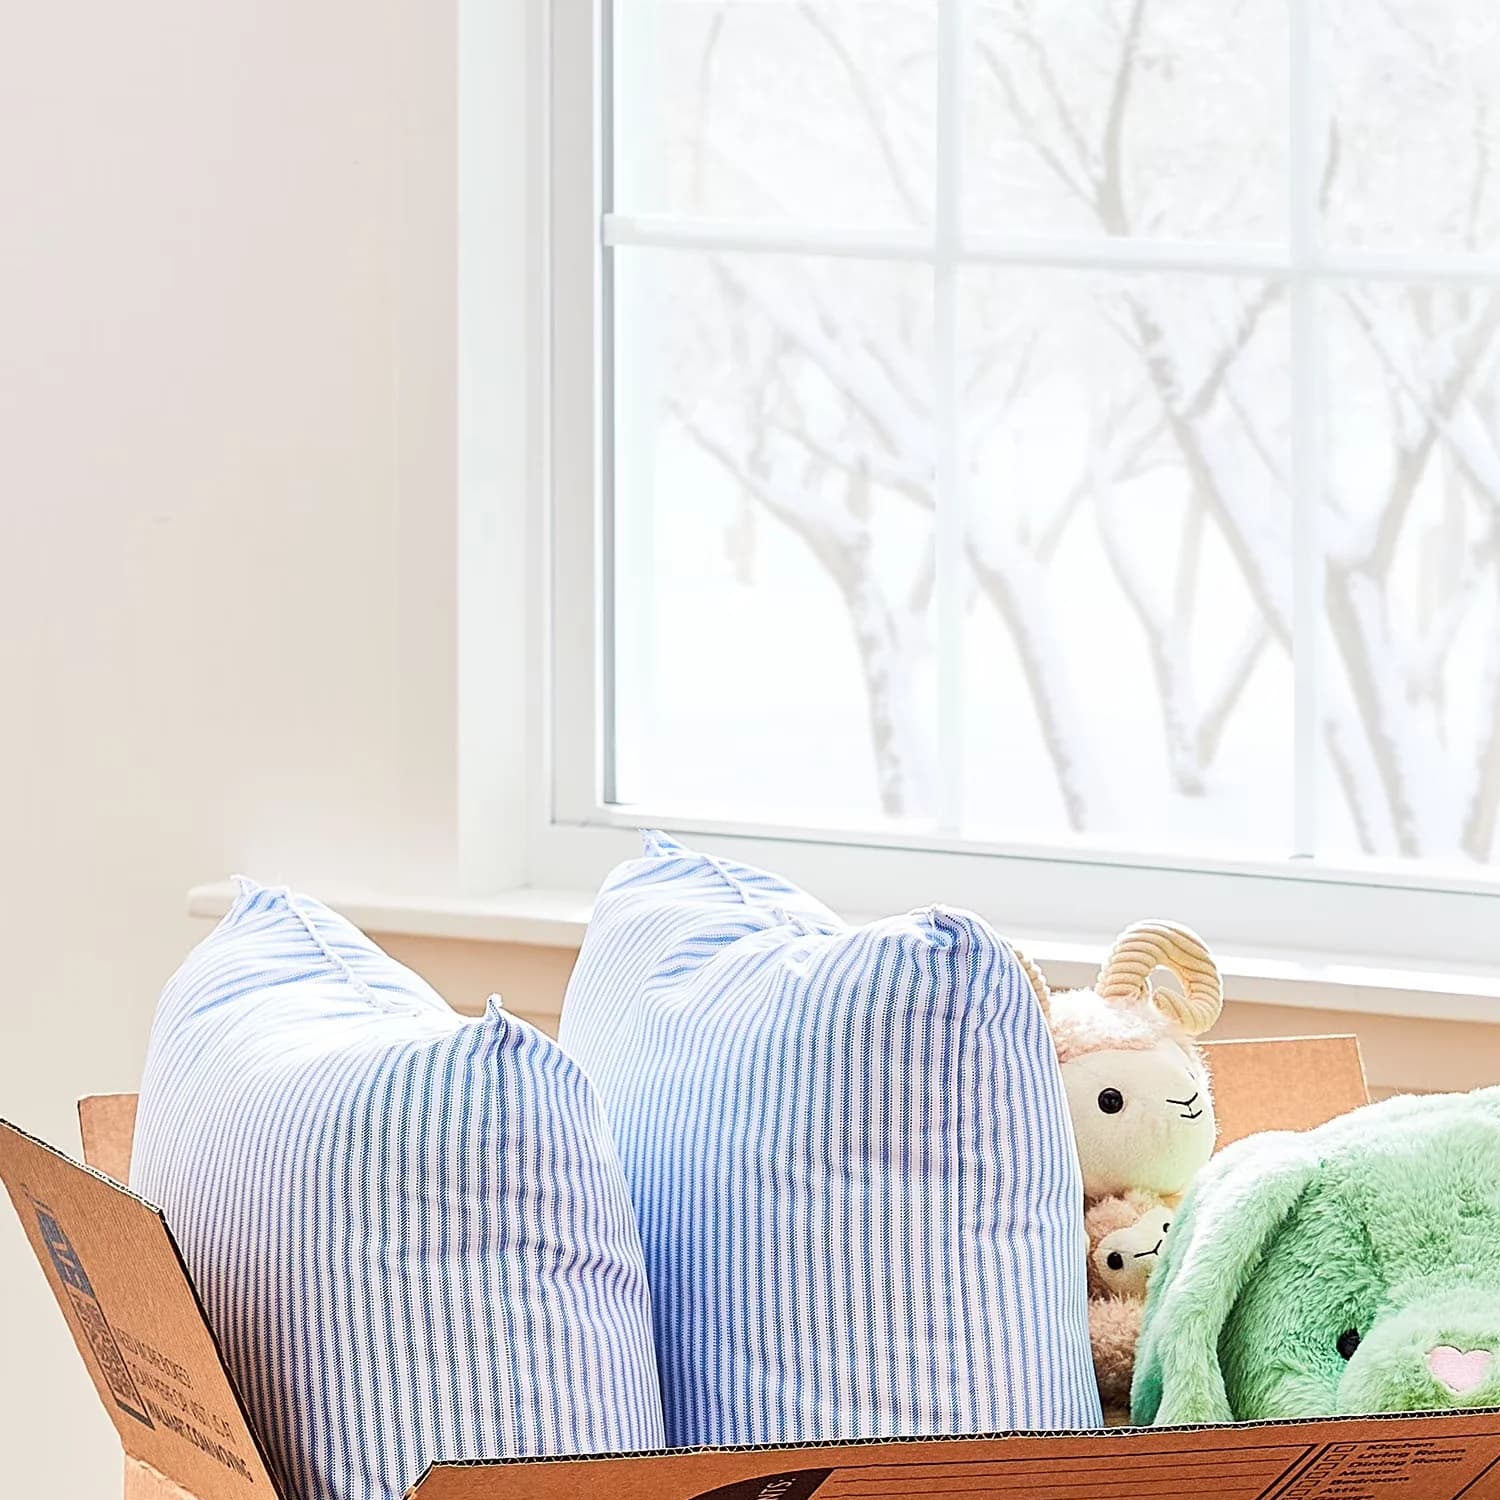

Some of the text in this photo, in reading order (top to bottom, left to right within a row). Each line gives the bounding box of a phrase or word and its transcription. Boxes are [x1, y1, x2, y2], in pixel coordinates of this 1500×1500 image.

[1366, 1441, 1435, 1451] Kitchen
[1357, 1448, 1467, 1460] Living Room
[1348, 1459, 1407, 1468] Dining
[1337, 1468, 1402, 1477] Master
